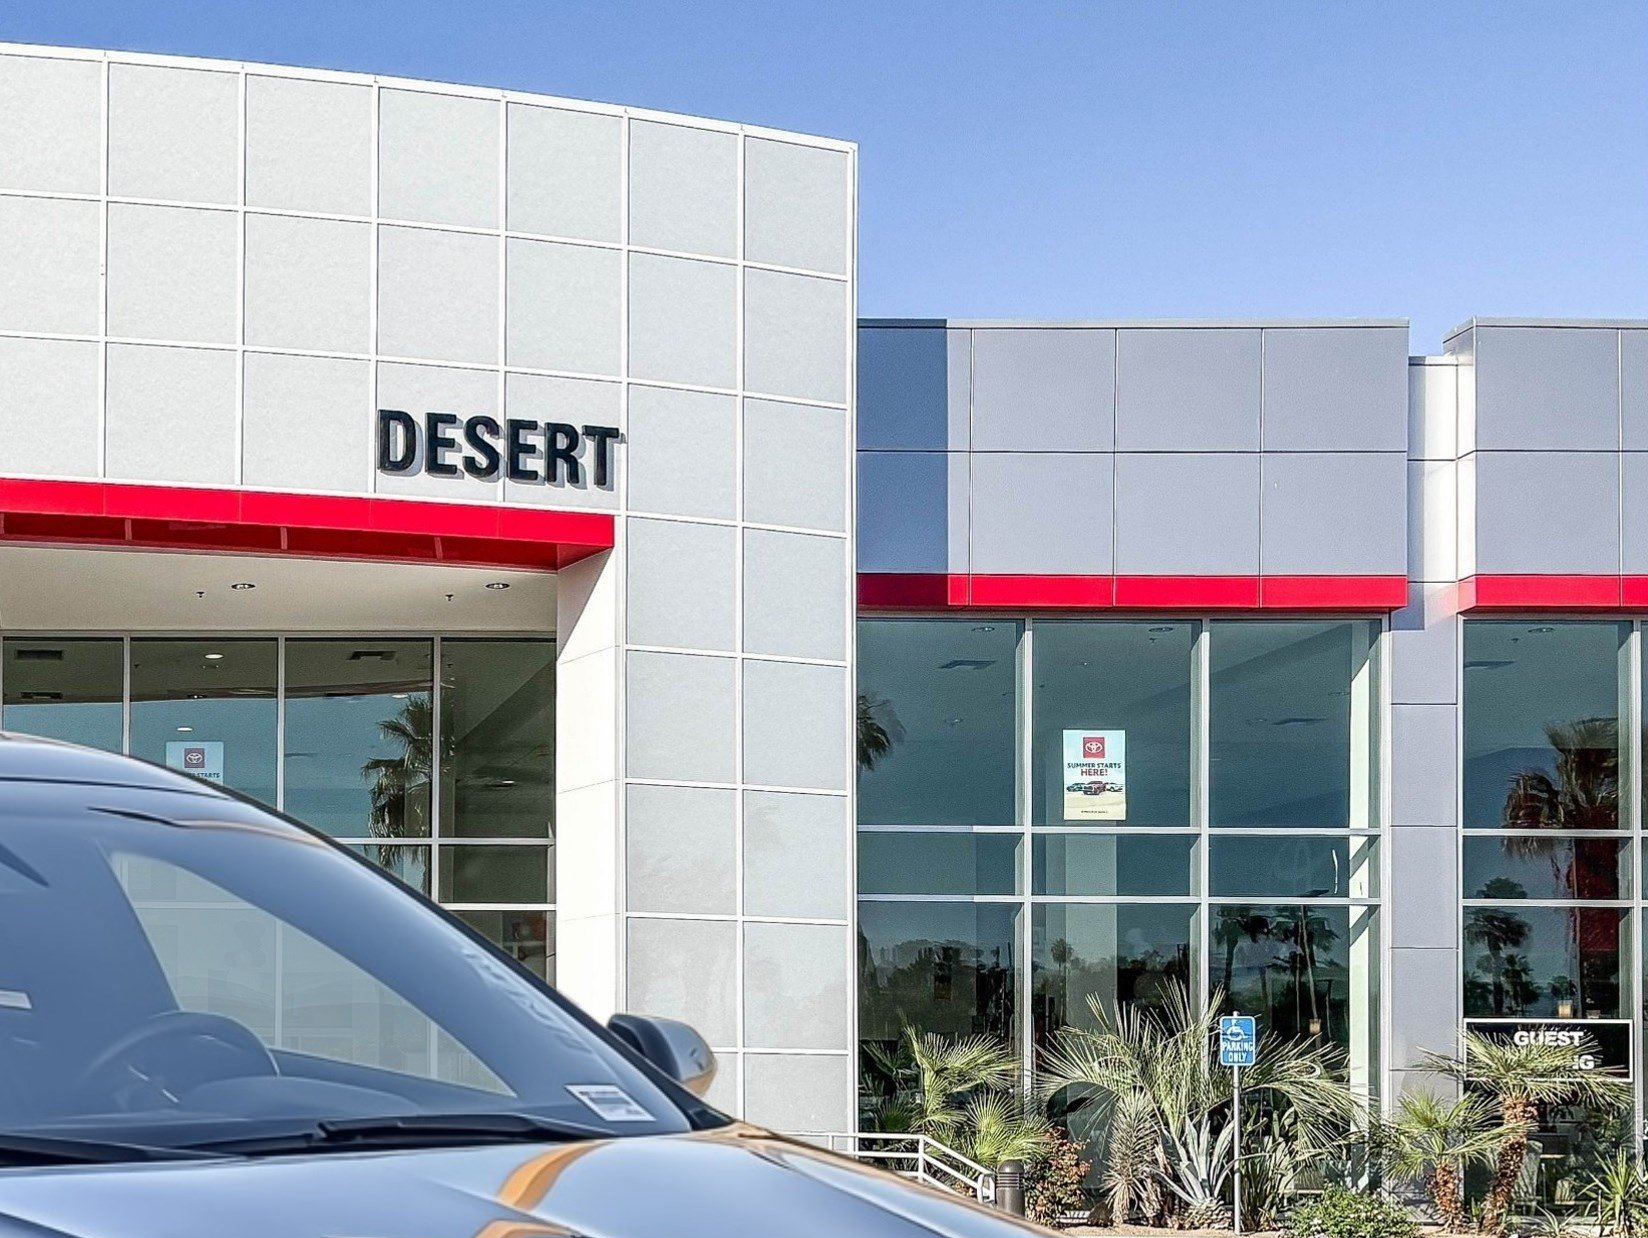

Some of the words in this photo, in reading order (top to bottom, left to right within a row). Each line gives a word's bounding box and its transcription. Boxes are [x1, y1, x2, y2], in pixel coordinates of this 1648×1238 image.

[376, 408, 620, 487] DESERT
[1080, 768, 1108, 776] HERE!
[1513, 1030, 1585, 1047] GUEST
[1222, 1041, 1253, 1052] PARKING
[1228, 1051, 1247, 1063] ONLY
